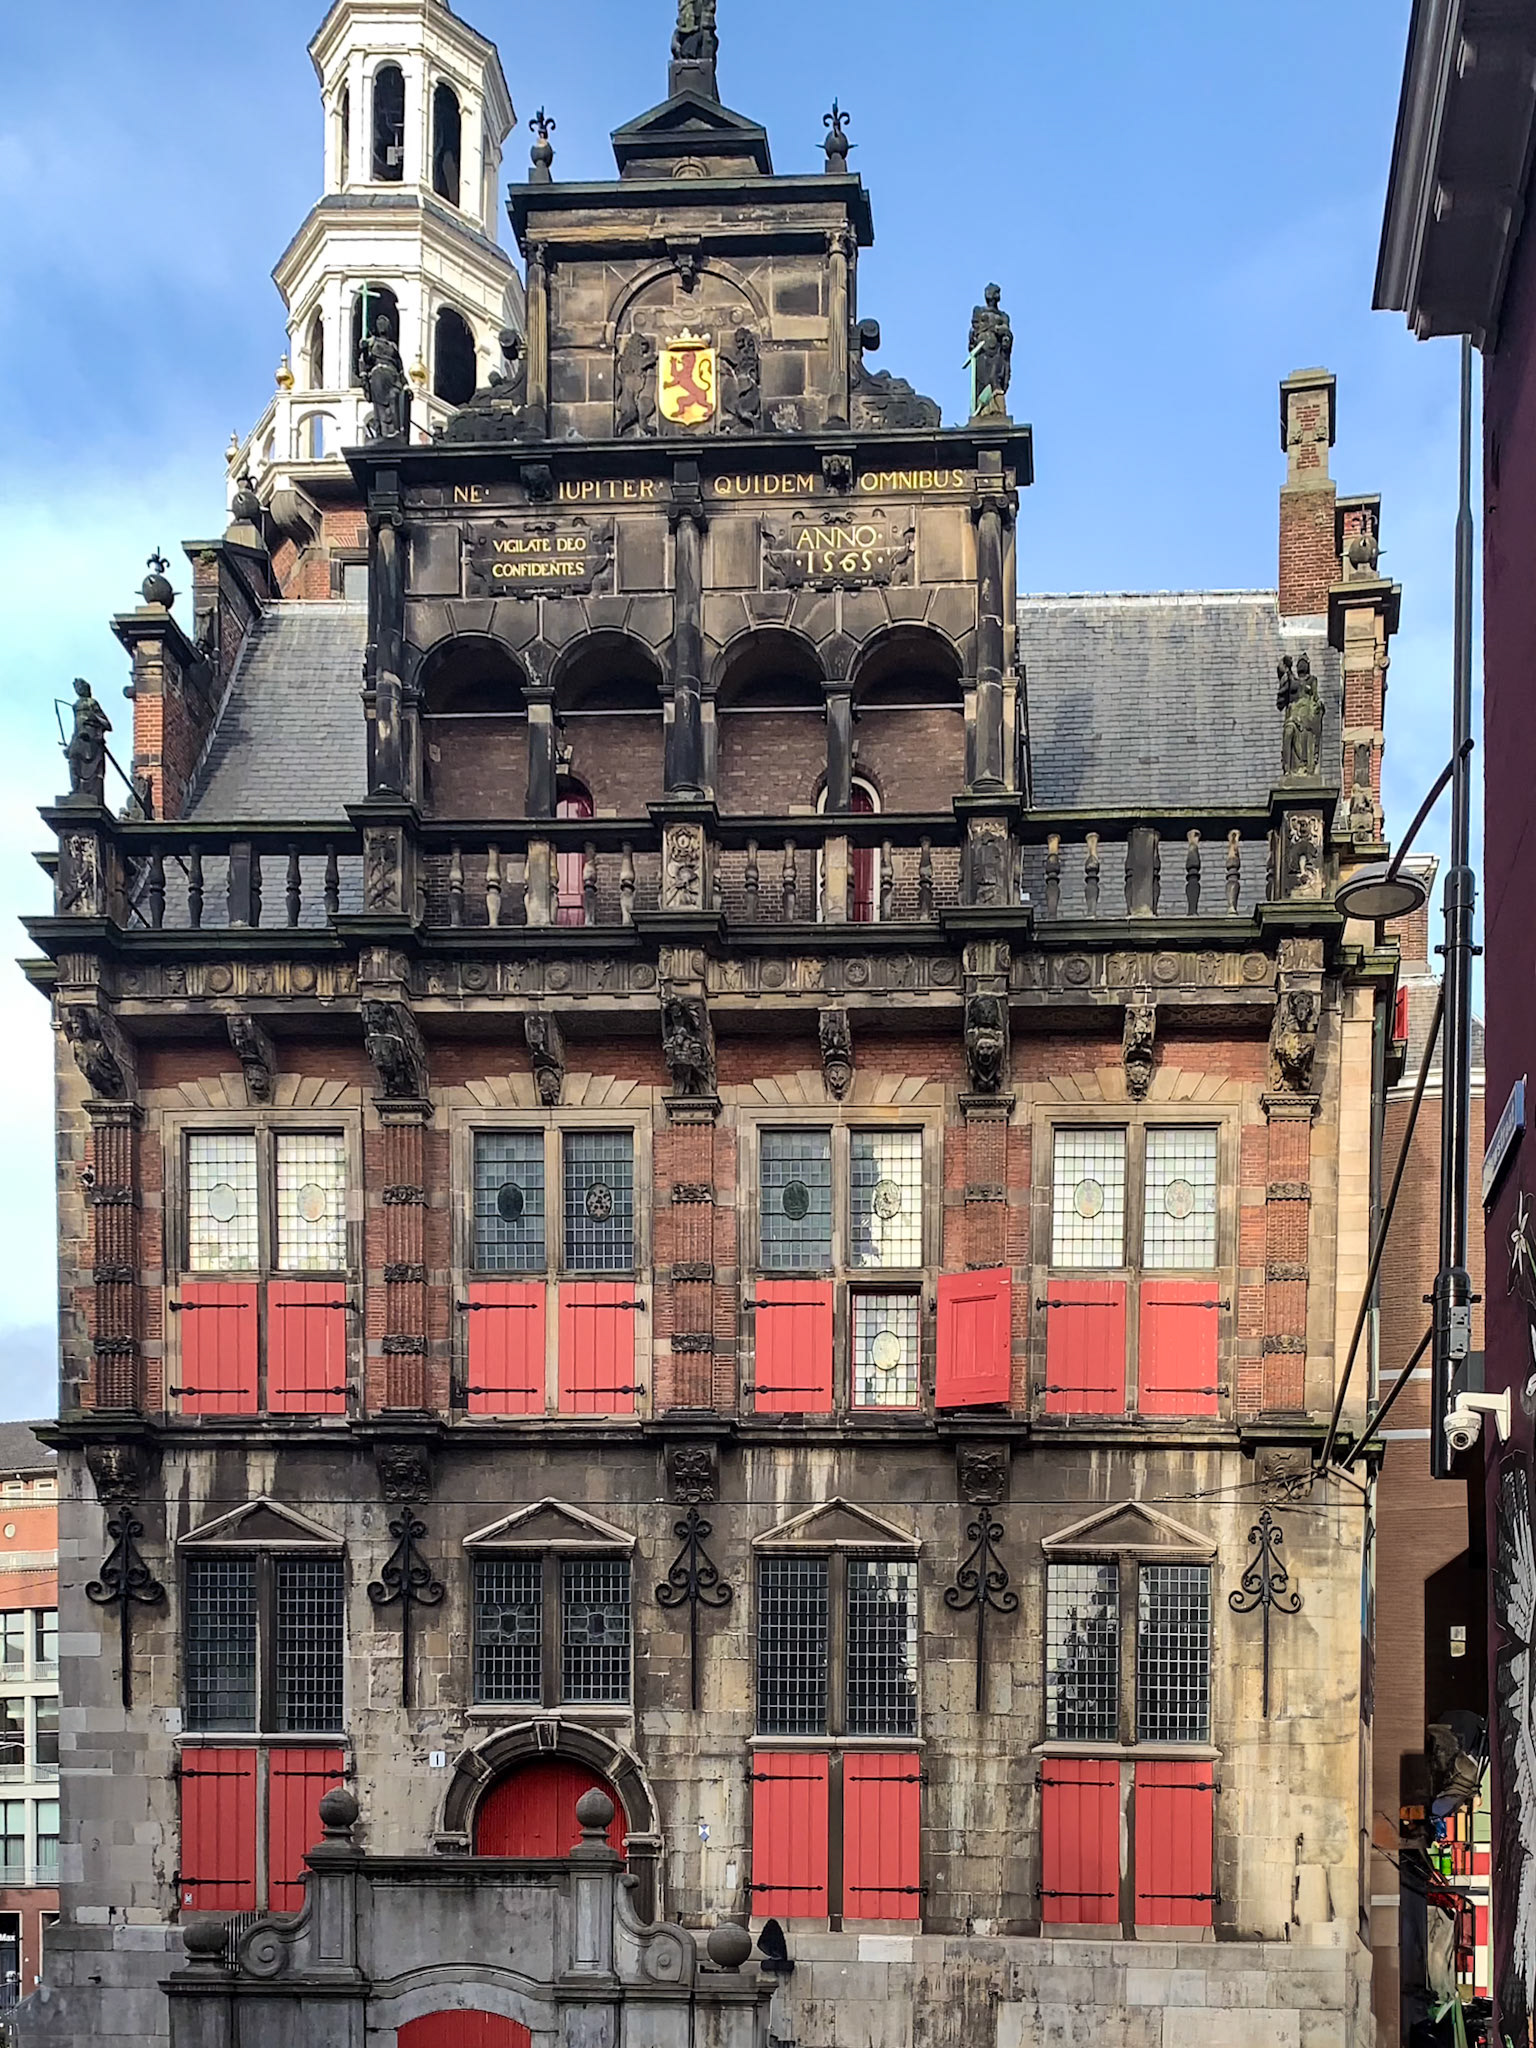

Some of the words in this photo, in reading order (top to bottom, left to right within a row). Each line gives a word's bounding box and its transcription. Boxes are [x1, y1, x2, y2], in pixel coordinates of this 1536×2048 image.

[713, 474, 815, 495] QUIDEM
[860, 469, 964, 491] OMNIBUS
[492, 538, 552, 553] VIGILATE
[556, 537, 587, 552] DEO
[492, 561, 586, 578] CONFIDENTES
